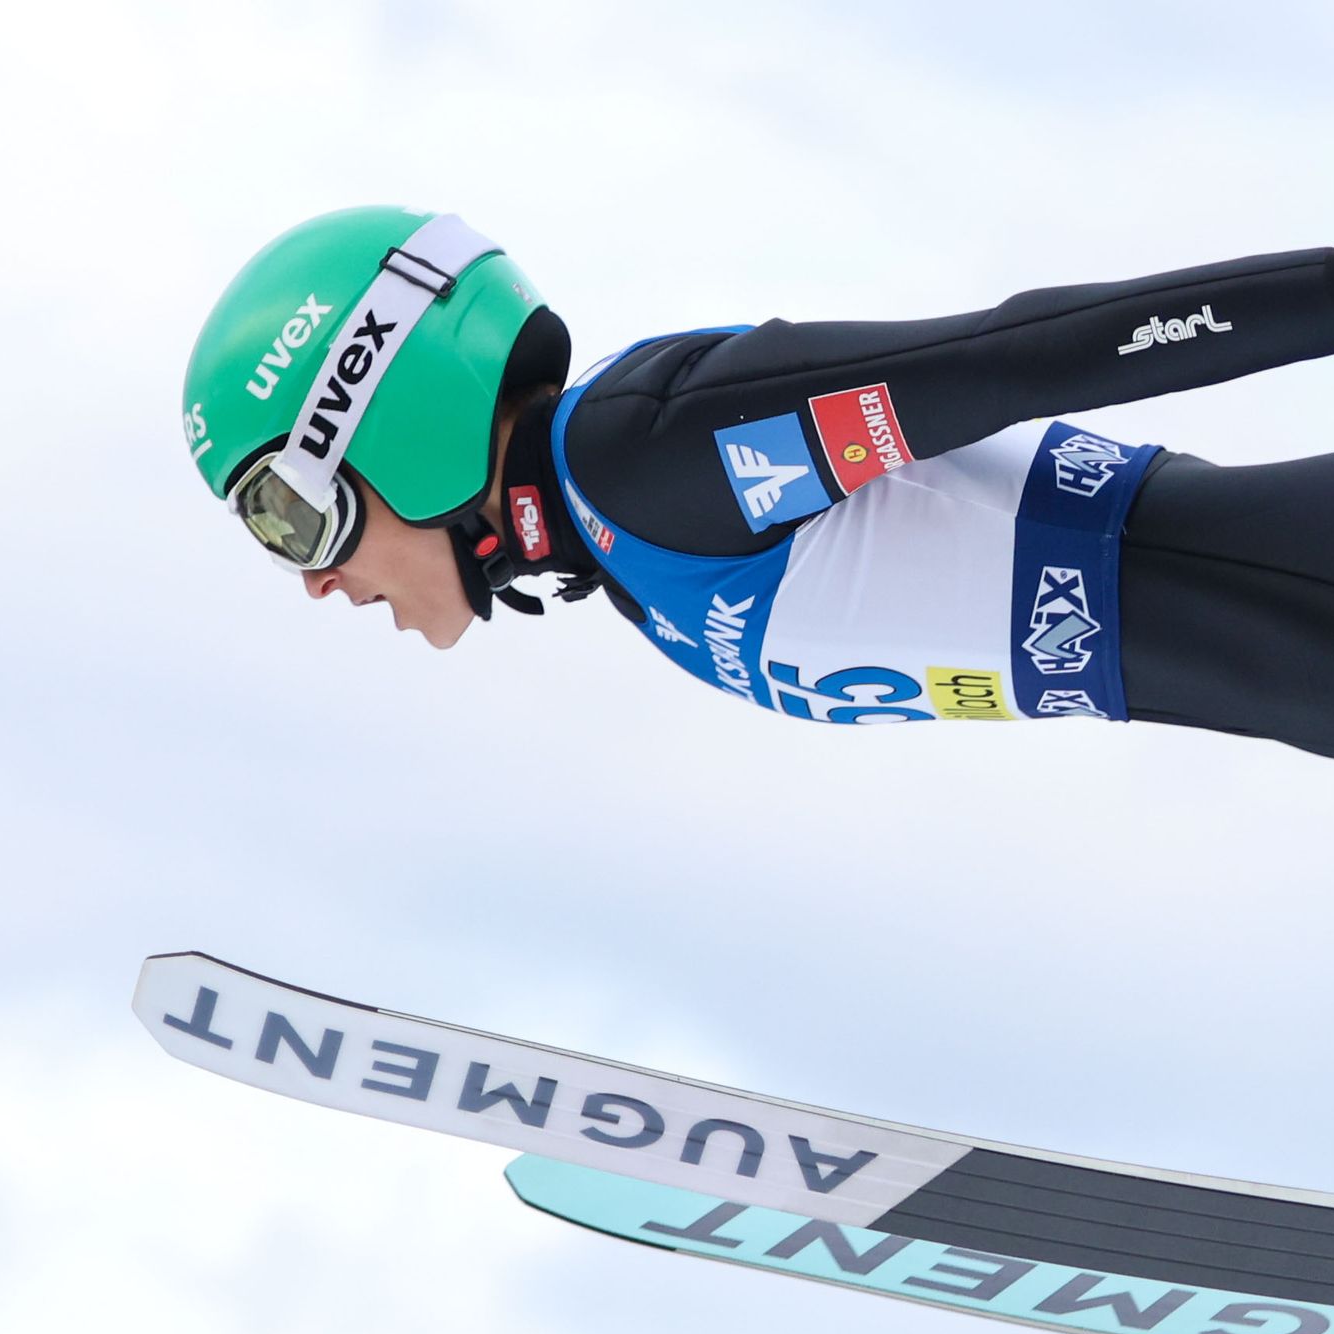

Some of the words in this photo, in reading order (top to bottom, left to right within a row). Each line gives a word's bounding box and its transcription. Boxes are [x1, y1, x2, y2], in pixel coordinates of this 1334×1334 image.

[245, 292, 333, 401] uvex
[298, 309, 398, 460] uvex
[516, 496, 540, 552] Tirol
[1021, 565, 1103, 675] HAIX
[163, 986, 879, 1194] AUGMENT
